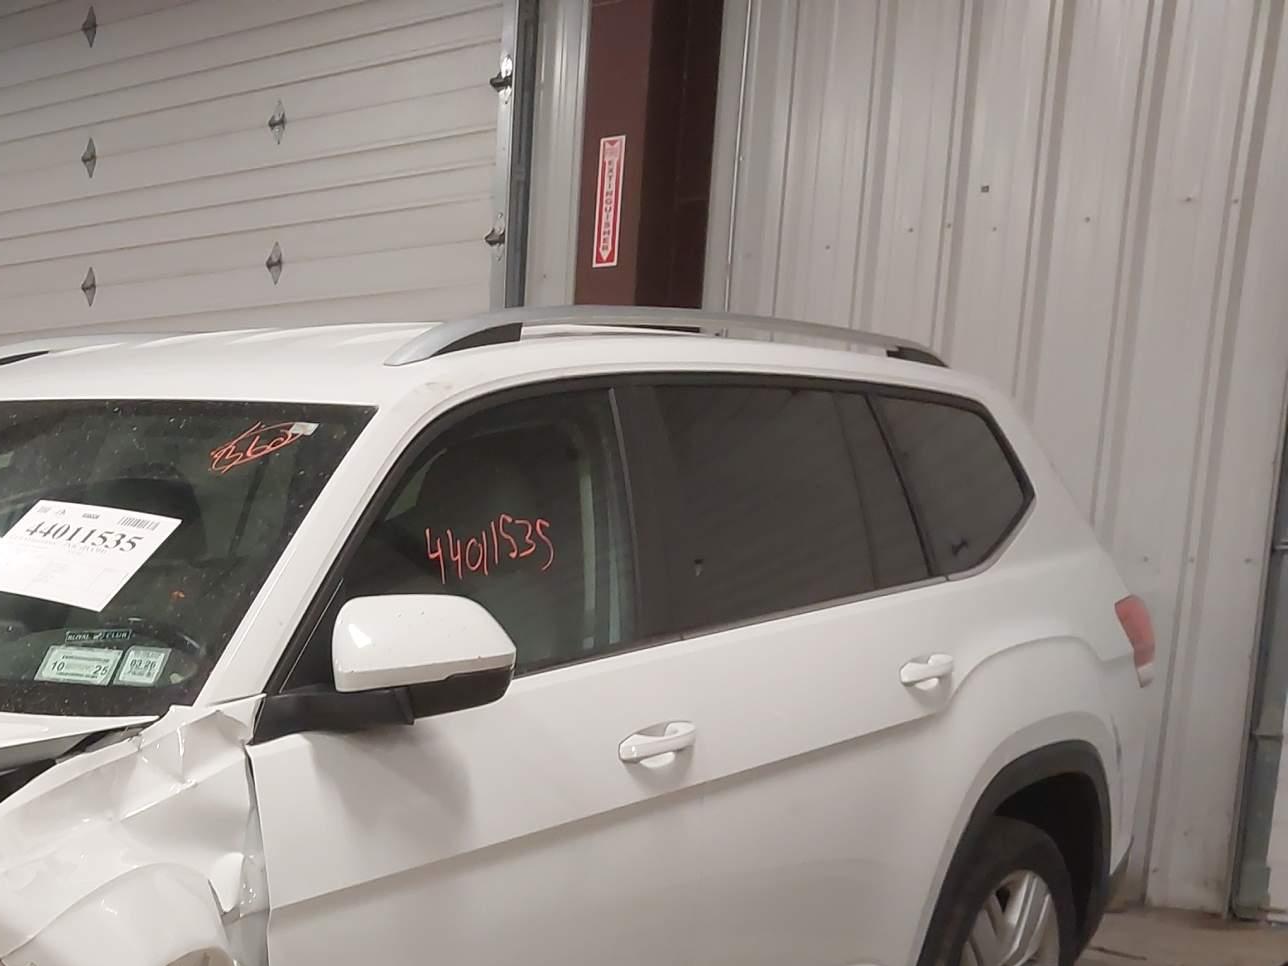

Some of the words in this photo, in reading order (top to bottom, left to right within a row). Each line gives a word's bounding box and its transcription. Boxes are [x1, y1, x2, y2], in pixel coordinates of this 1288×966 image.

[602, 159, 614, 251] EXTINGUISHER
[26, 521, 145, 552] 44011535
[424, 513, 554, 585] 44011535
[51, 661, 65, 672] 10
[93, 665, 108, 676] 25
